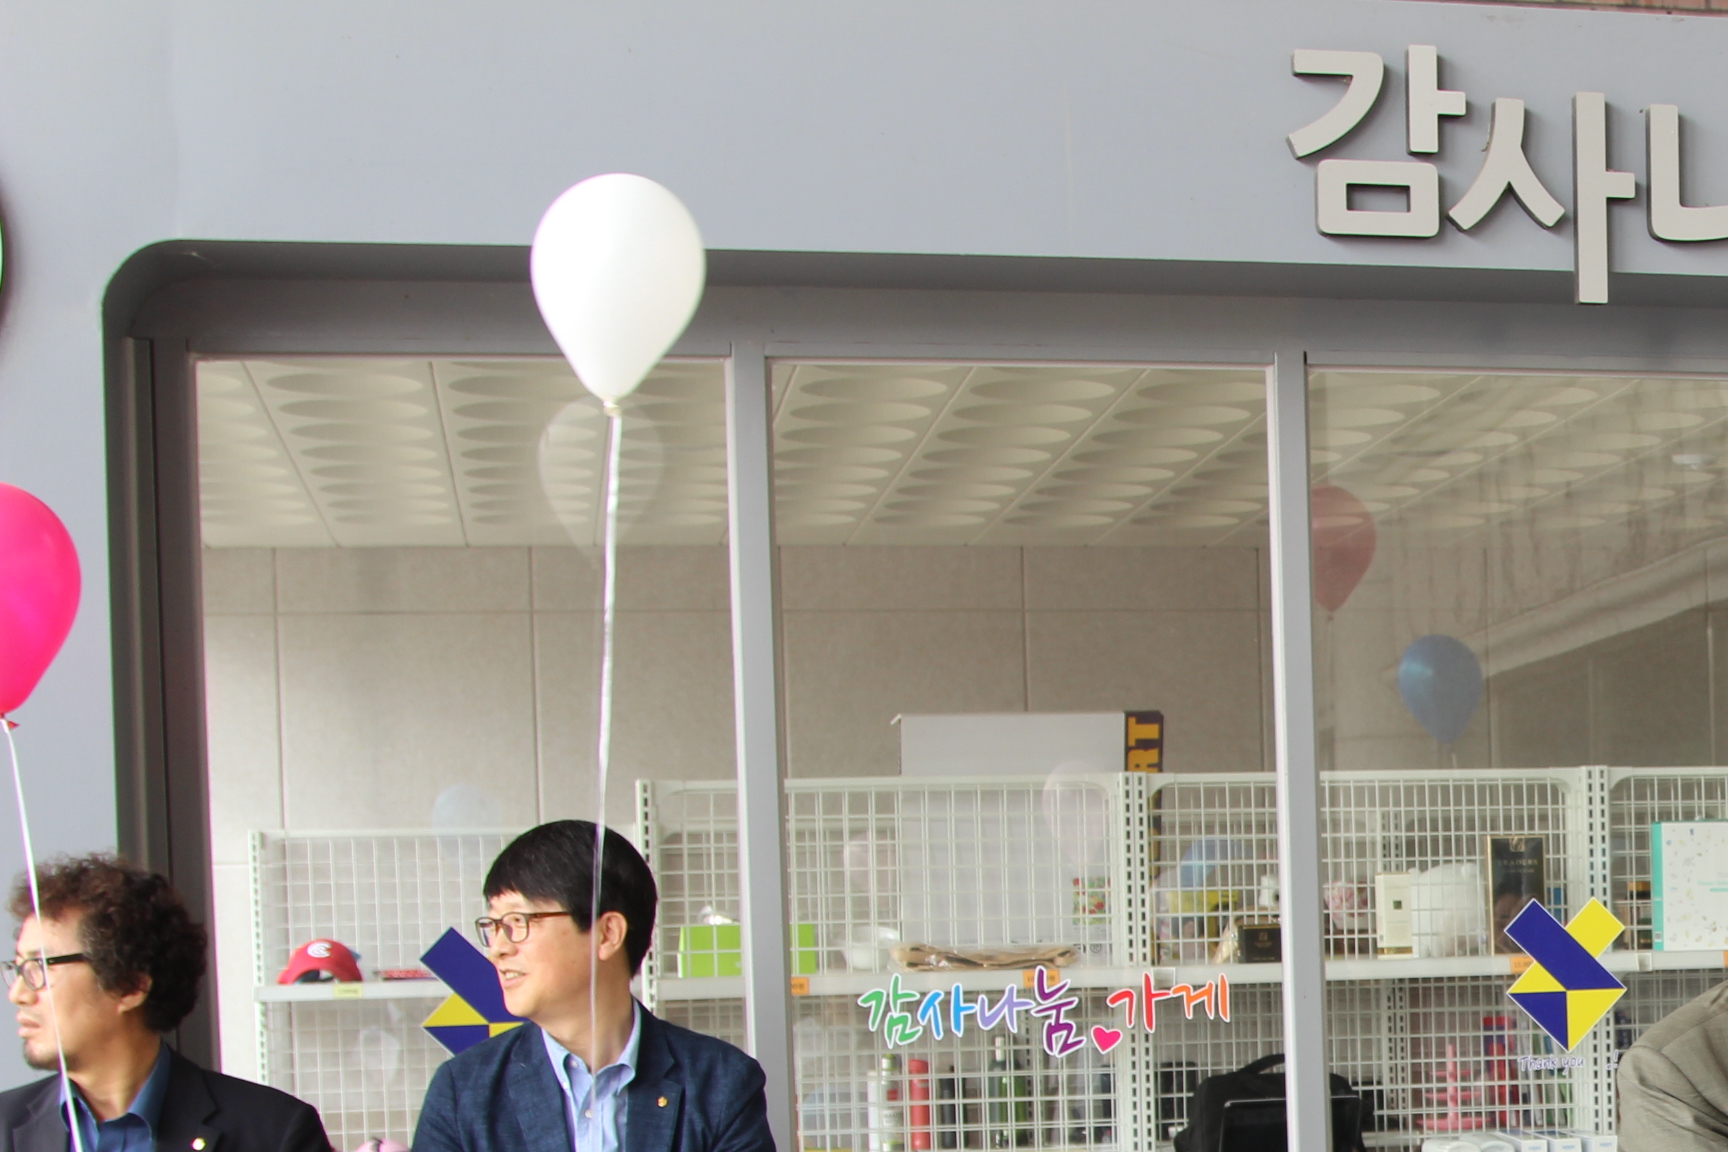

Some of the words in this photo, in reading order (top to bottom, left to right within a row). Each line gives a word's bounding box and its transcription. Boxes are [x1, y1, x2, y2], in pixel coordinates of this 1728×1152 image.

[857, 965, 1087, 1058] 감사나눔
[1106, 971, 1231, 1034] 가게
[1518, 1053, 1558, 1072] Thank
[1561, 1056, 1585, 1076] you
